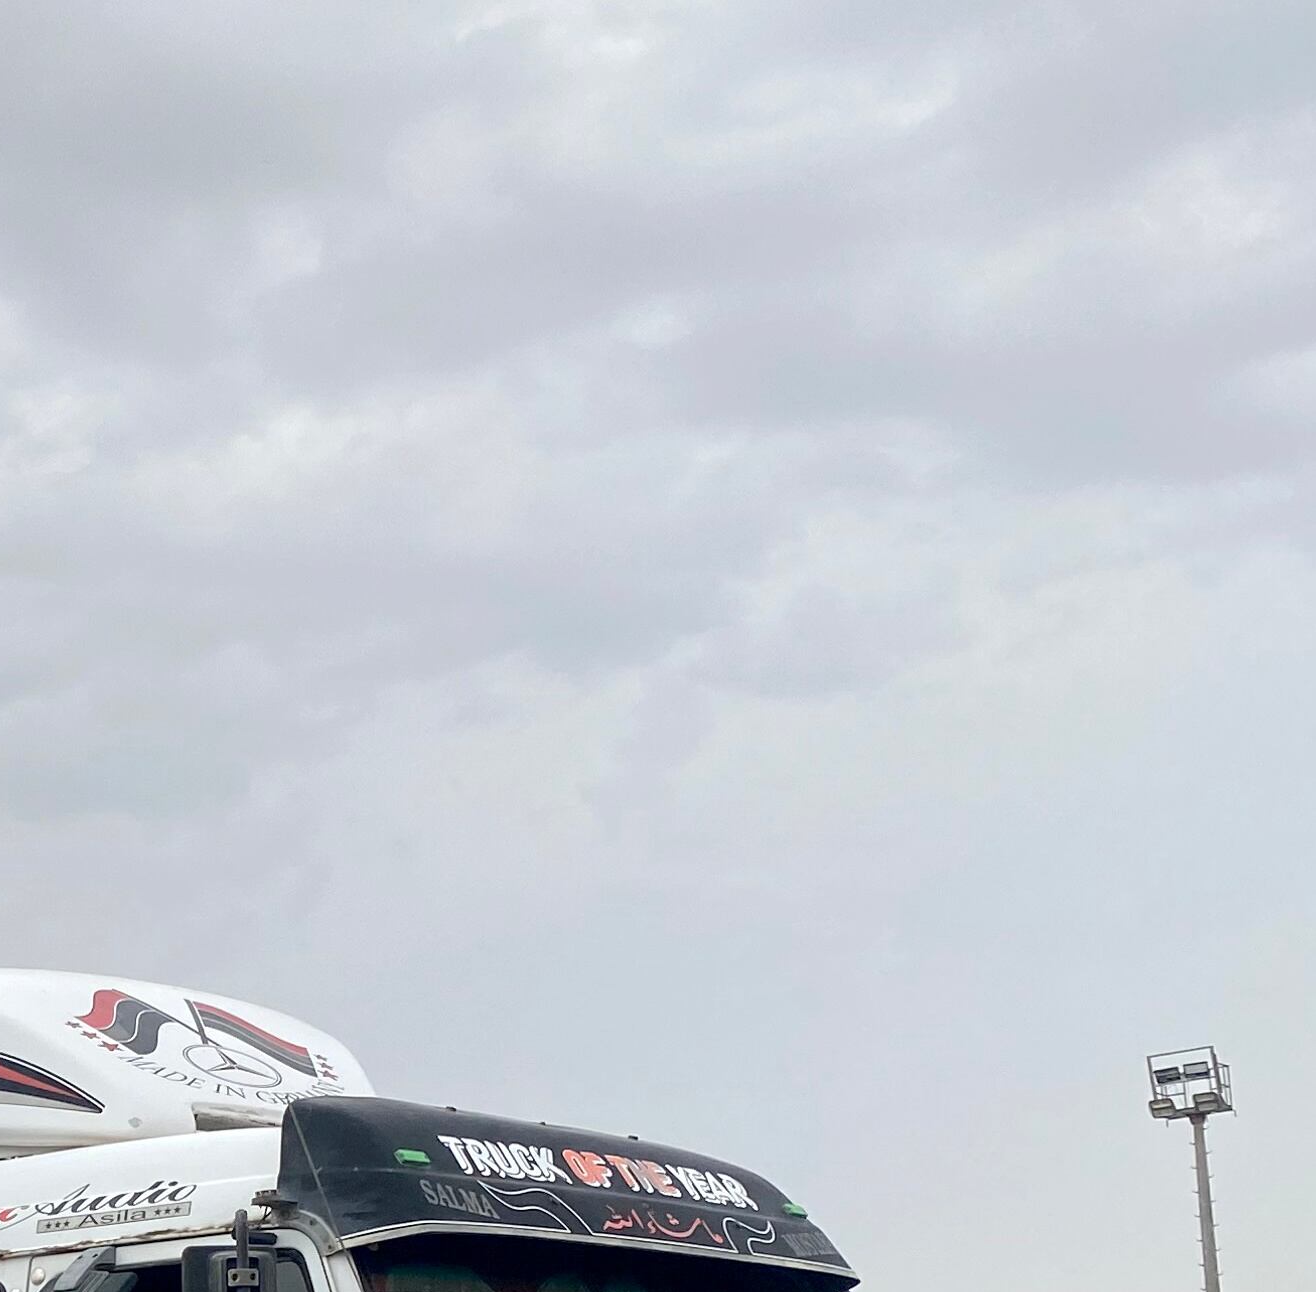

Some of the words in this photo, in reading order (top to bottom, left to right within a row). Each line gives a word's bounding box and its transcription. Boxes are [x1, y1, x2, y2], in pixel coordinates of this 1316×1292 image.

[118, 1056, 204, 1089] MADE
[215, 1083, 245, 1099] IN
[437, 1135, 573, 1184] TRUCK
[562, 1148, 613, 1188] OF
[605, 1154, 682, 1198] THE
[665, 1164, 759, 1211] YEAR
[35, 1180, 197, 1215] Audio
[79, 1208, 146, 1227] Asila
[419, 1179, 500, 1220] SALMA
